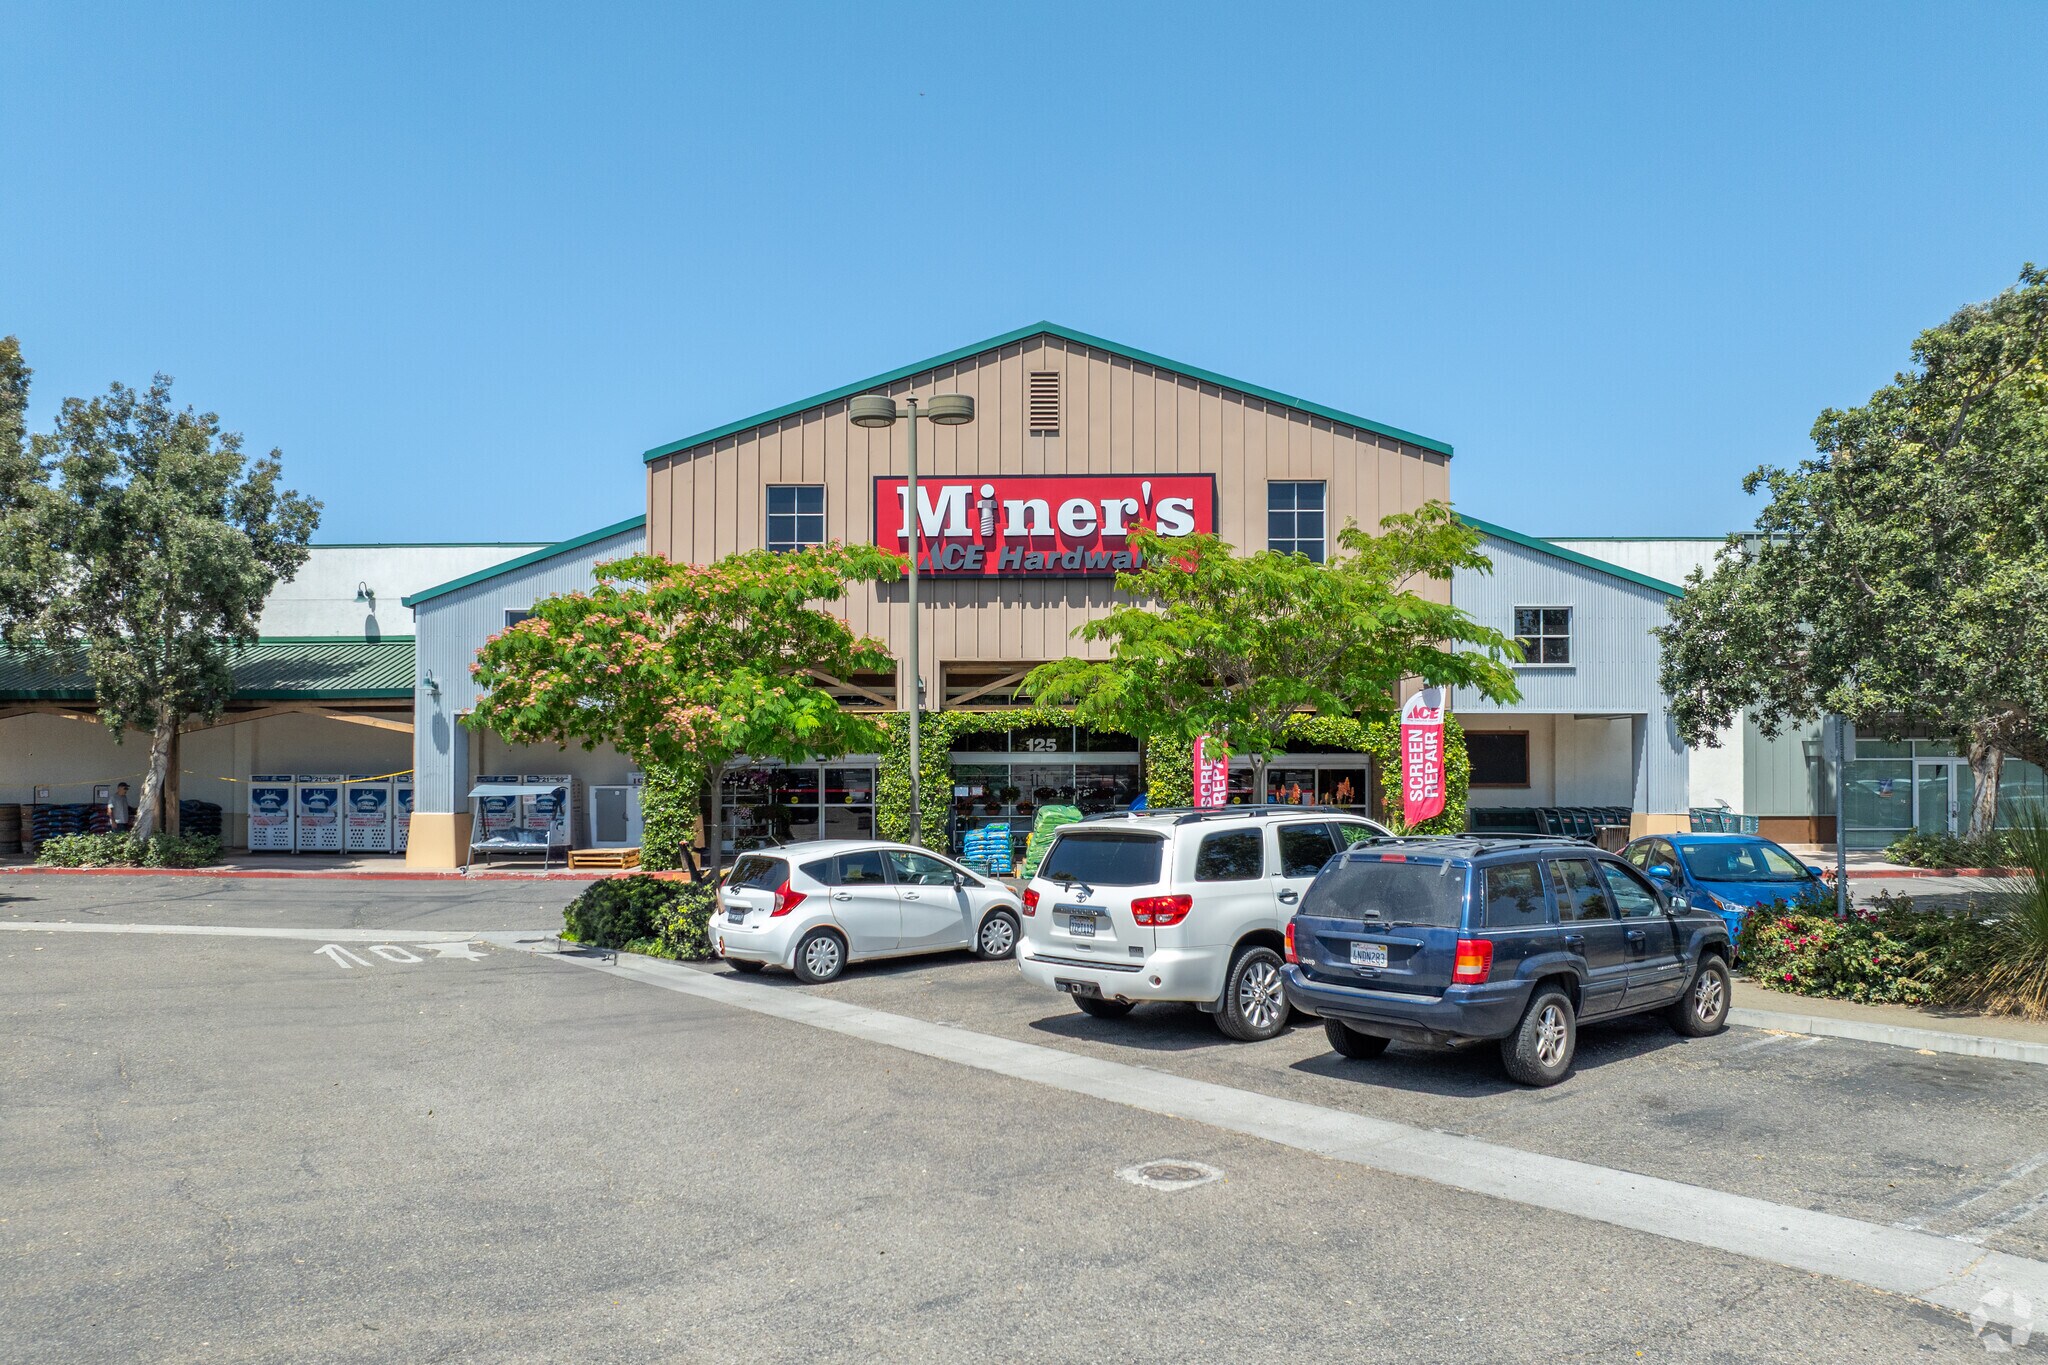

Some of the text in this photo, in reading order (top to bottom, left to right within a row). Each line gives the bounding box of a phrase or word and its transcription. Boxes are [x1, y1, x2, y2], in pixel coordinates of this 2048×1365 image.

[897, 480, 1194, 537] Miner's
[919, 541, 1150, 571] ACE Hardwar
[1407, 704, 1439, 719] ACE
[1026, 738, 1058, 752] 125
[1408, 729, 1424, 802] SCREEN
[1424, 731, 1439, 798] REPAIR
[1301, 957, 1316, 966] Jeep
